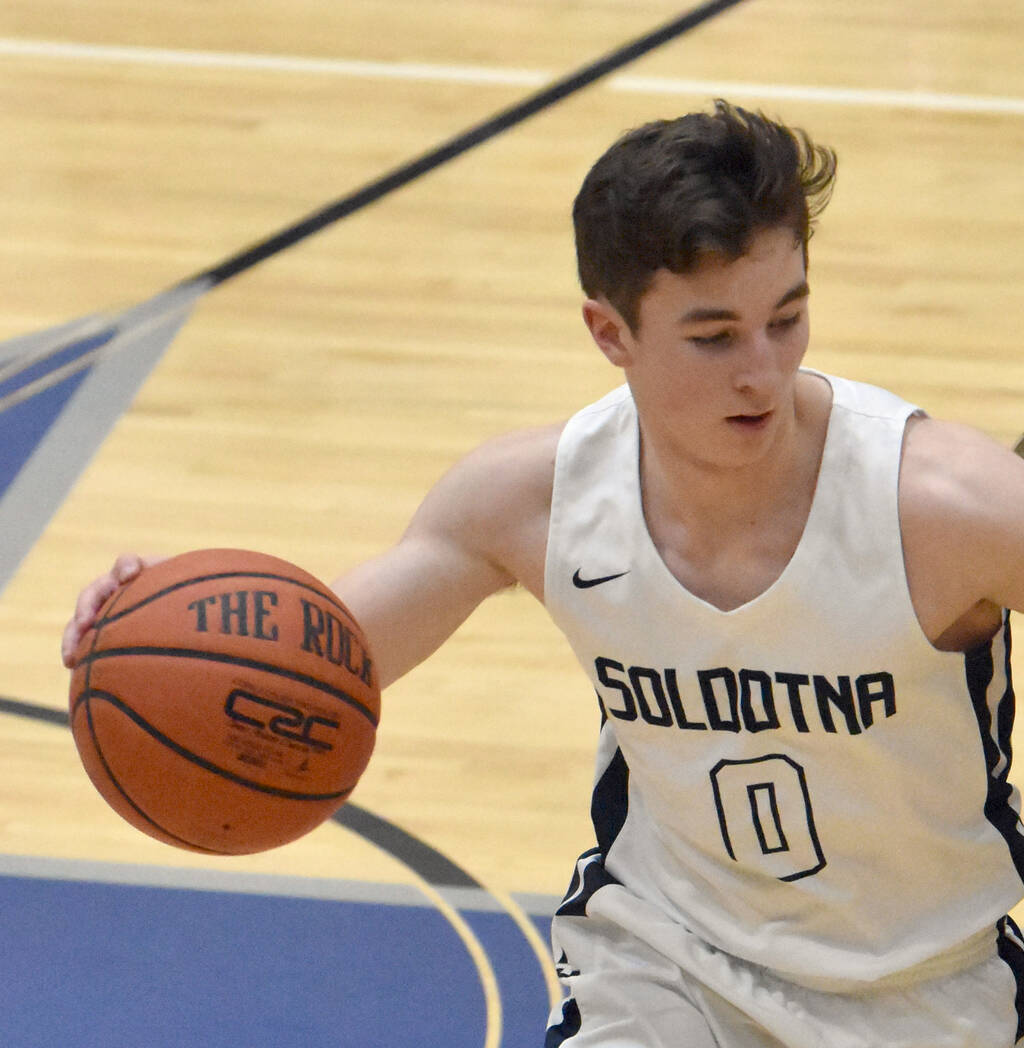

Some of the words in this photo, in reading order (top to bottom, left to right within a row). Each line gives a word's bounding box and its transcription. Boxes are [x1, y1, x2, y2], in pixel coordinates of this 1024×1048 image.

[188, 590, 278, 642] THE
[594, 656, 897, 735] SOLDOTNA
[709, 753, 828, 883] 0
